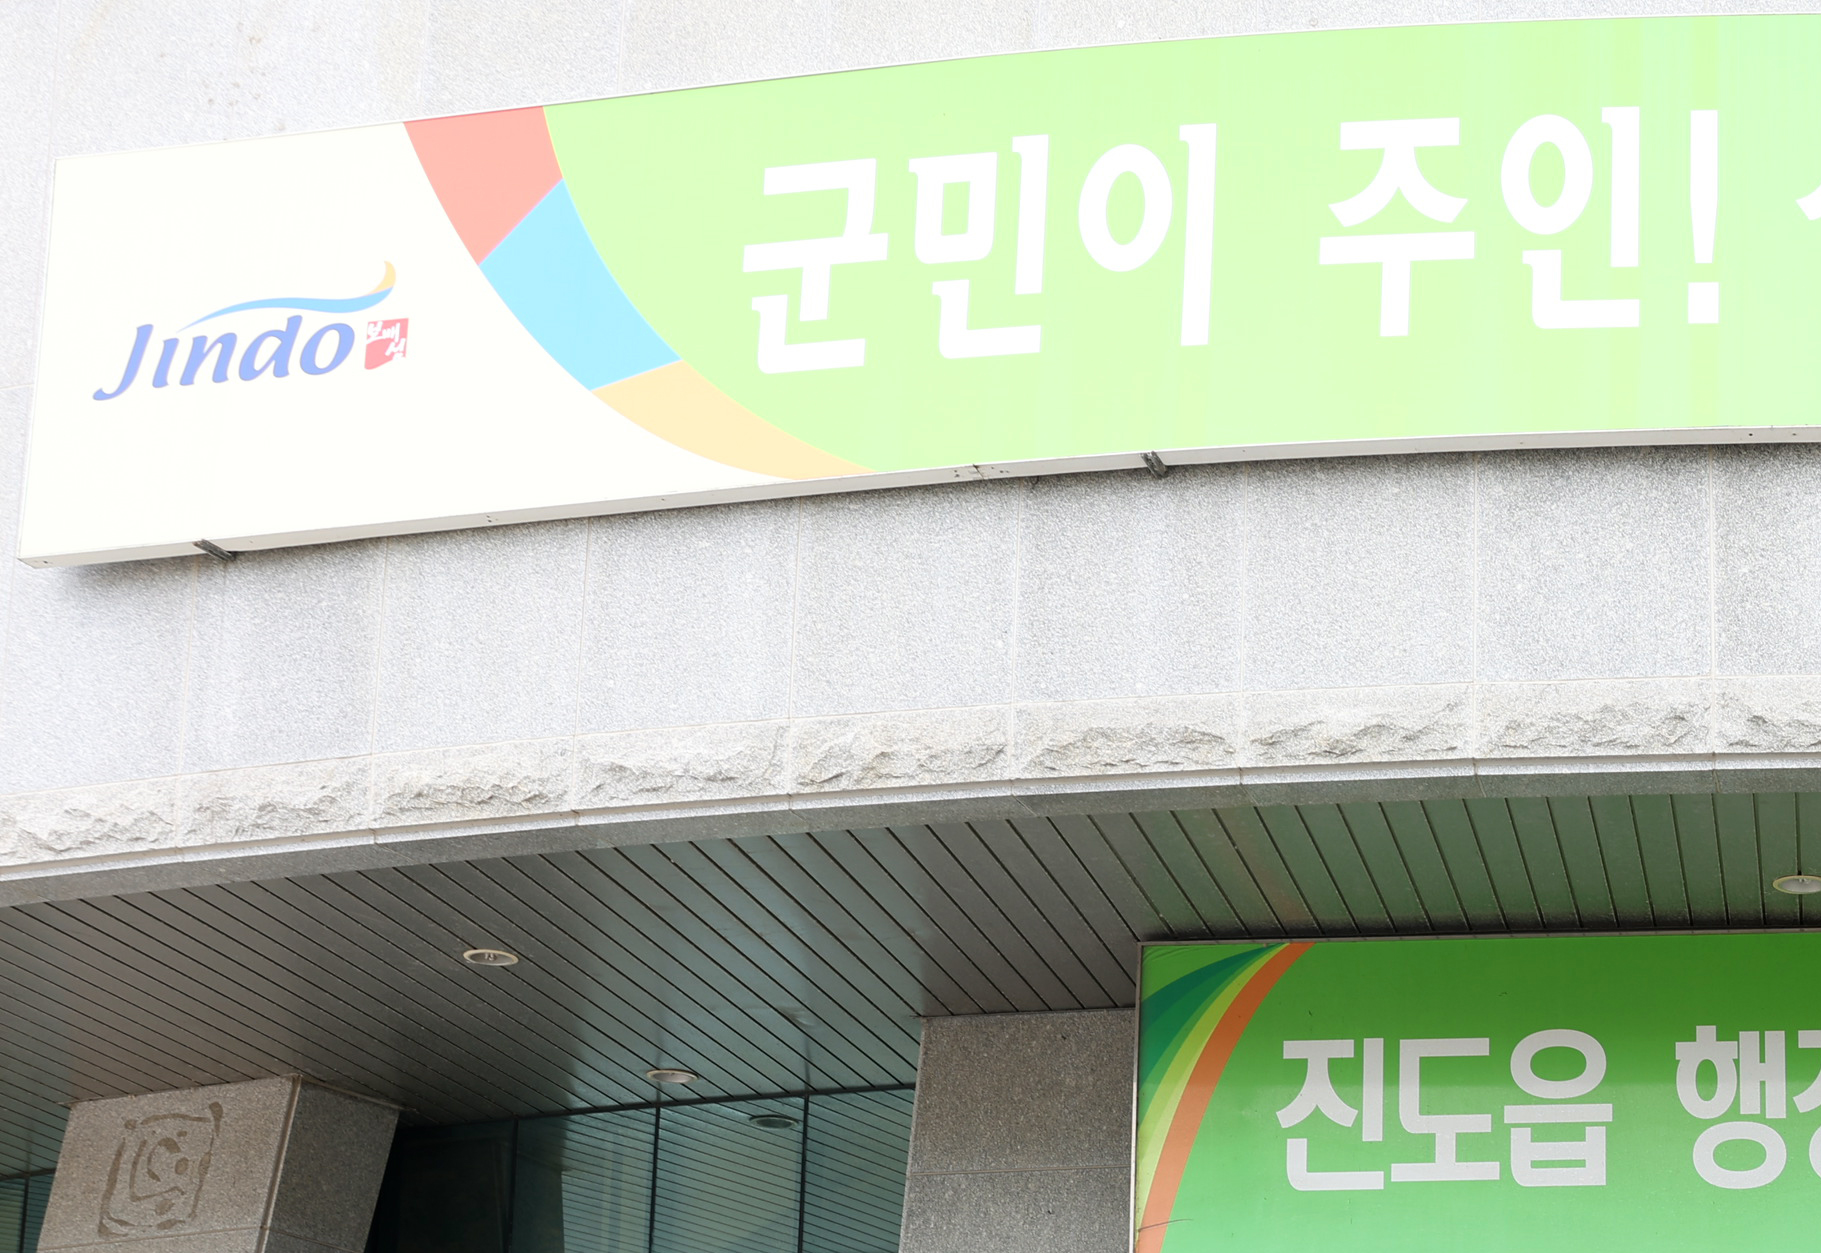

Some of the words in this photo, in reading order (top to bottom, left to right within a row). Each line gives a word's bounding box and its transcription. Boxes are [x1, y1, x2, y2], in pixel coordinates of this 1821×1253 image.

[743, 123, 1217, 374] 군민이
[1319, 106, 1720, 336] 주인!
[92, 315, 355, 400] Jindo
[1276, 1030, 1614, 1191] 진도읍
